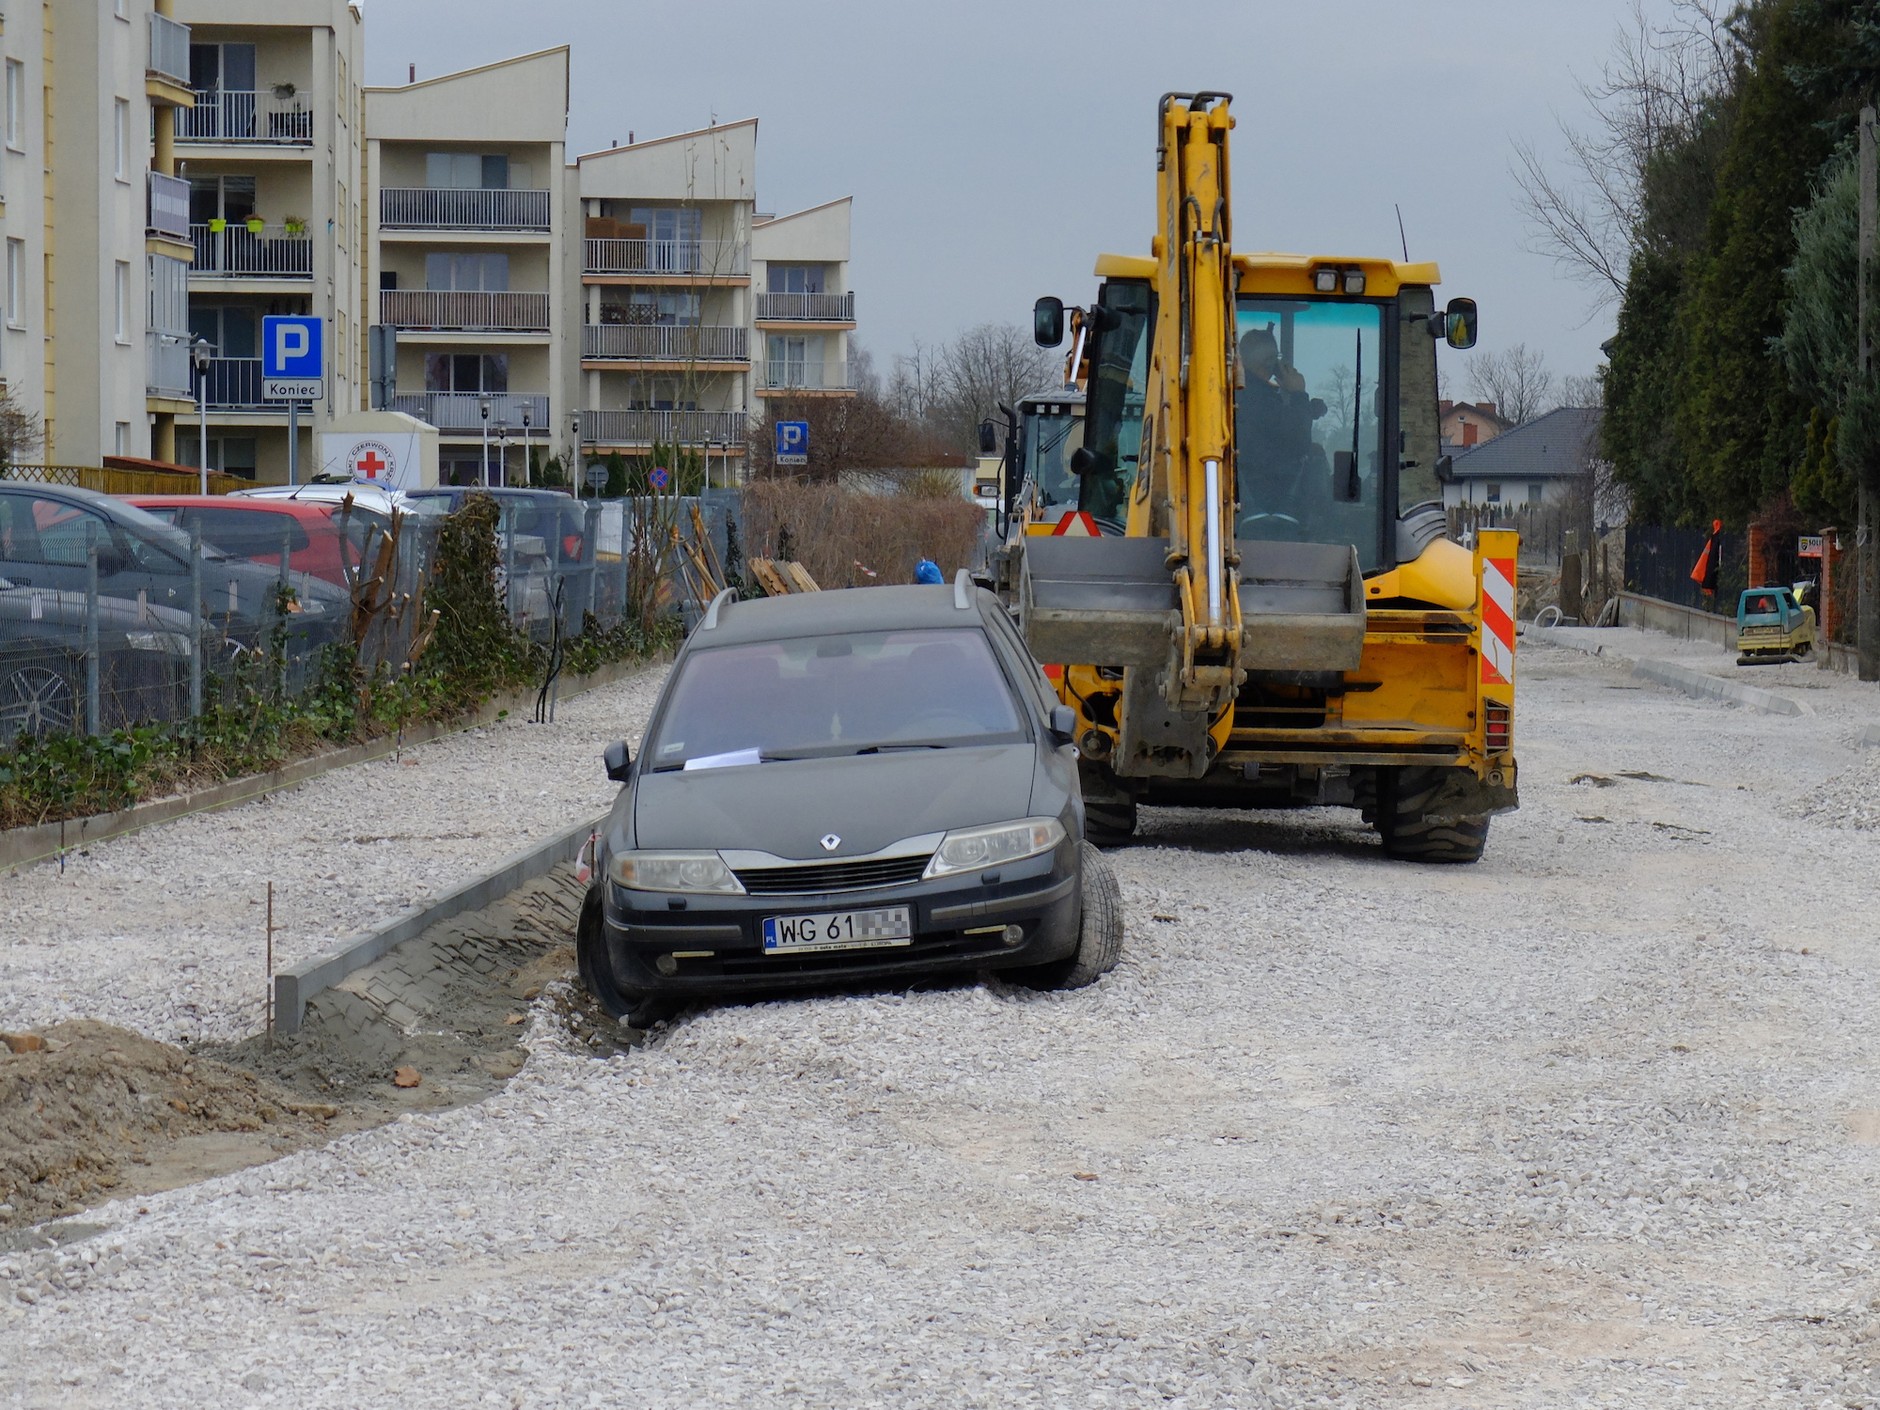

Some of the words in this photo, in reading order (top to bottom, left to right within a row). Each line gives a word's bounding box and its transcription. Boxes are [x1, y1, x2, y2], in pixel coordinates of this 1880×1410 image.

[276, 323, 309, 371] P
[270, 383, 315, 395] Koniec
[783, 425, 802, 451] P
[352, 441, 393, 458] CZERWONY
[765, 935, 776, 944] PL
[780, 919, 817, 944] WG
